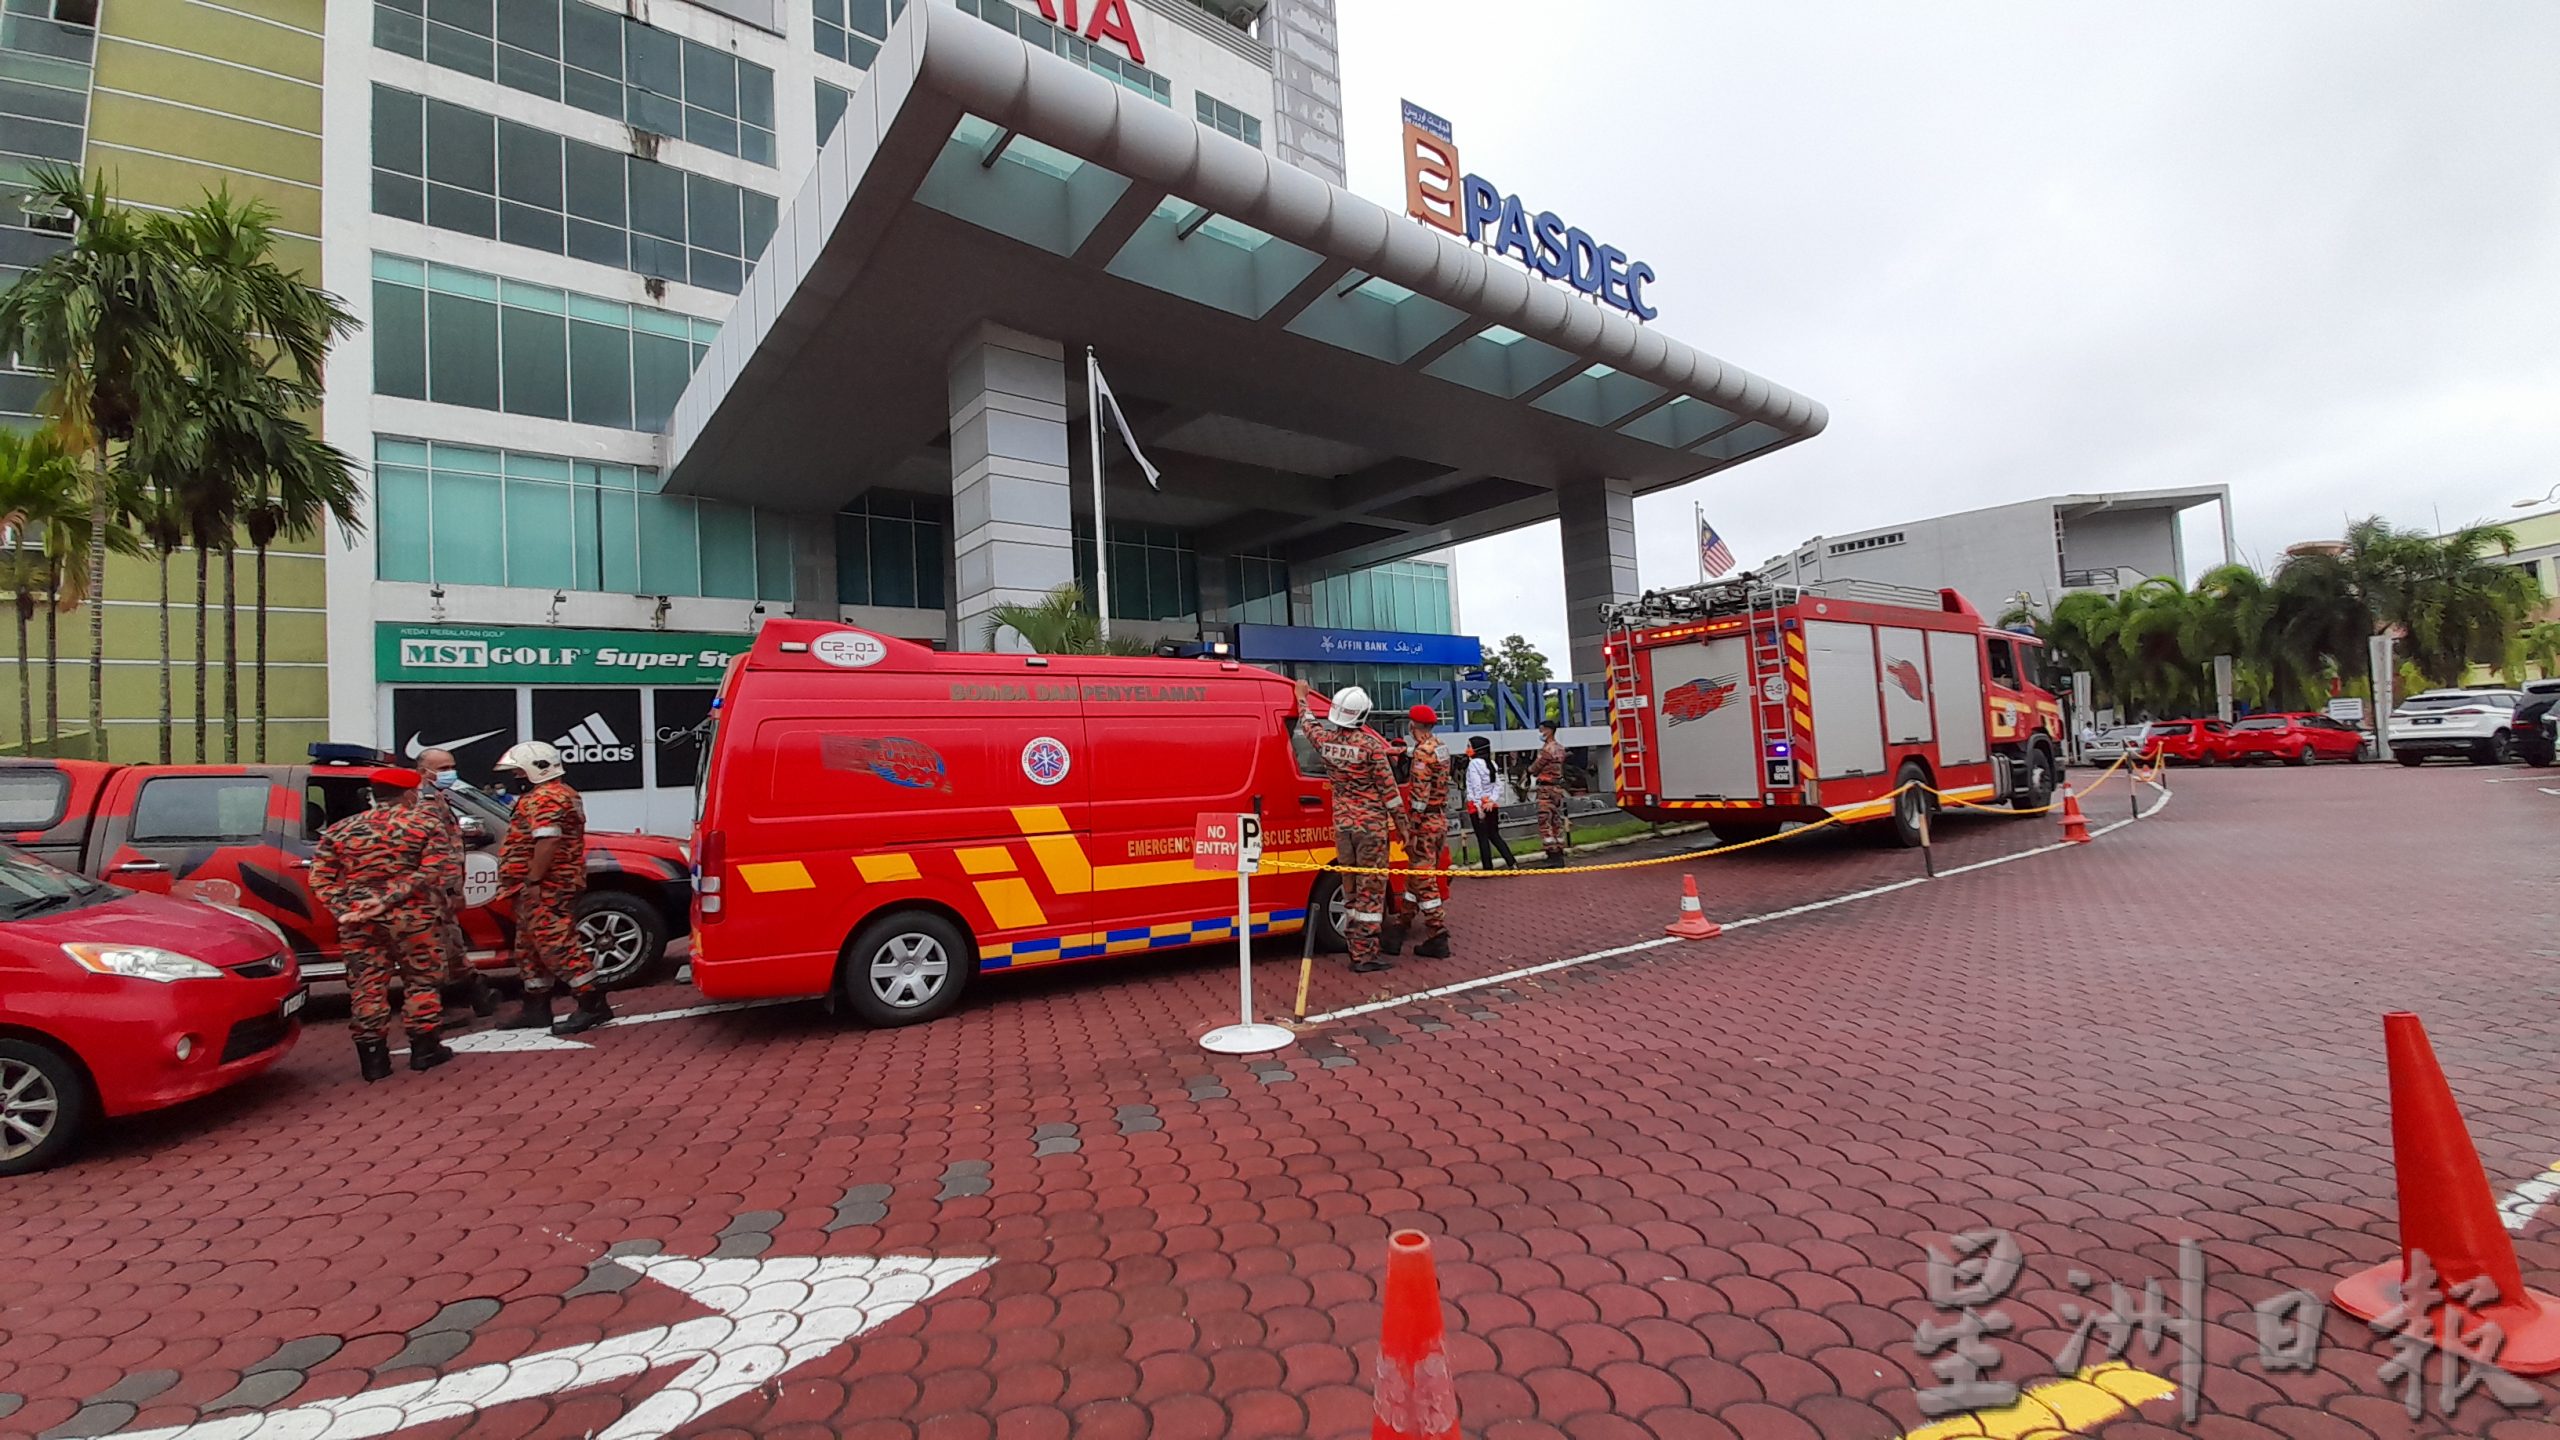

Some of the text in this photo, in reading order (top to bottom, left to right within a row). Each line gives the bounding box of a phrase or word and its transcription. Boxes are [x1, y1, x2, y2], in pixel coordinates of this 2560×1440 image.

[1463, 173, 1658, 321] PASDEC
[430, 629, 481, 637] PERALATAN
[820, 641, 878, 652] C2-01
[1337, 640, 1389, 652] AFFIN BANK
[406, 645, 483, 664] MST
[489, 646, 581, 666] GOLF
[594, 648, 693, 670] Super
[834, 653, 865, 661] KTN
[951, 684, 1207, 702] BOMBA DAN PENYELAMAT
[560, 744, 634, 763] didas
[1207, 825, 1226, 839] NO
[1242, 818, 1259, 848] P
[1195, 841, 1238, 855] ENTRY
